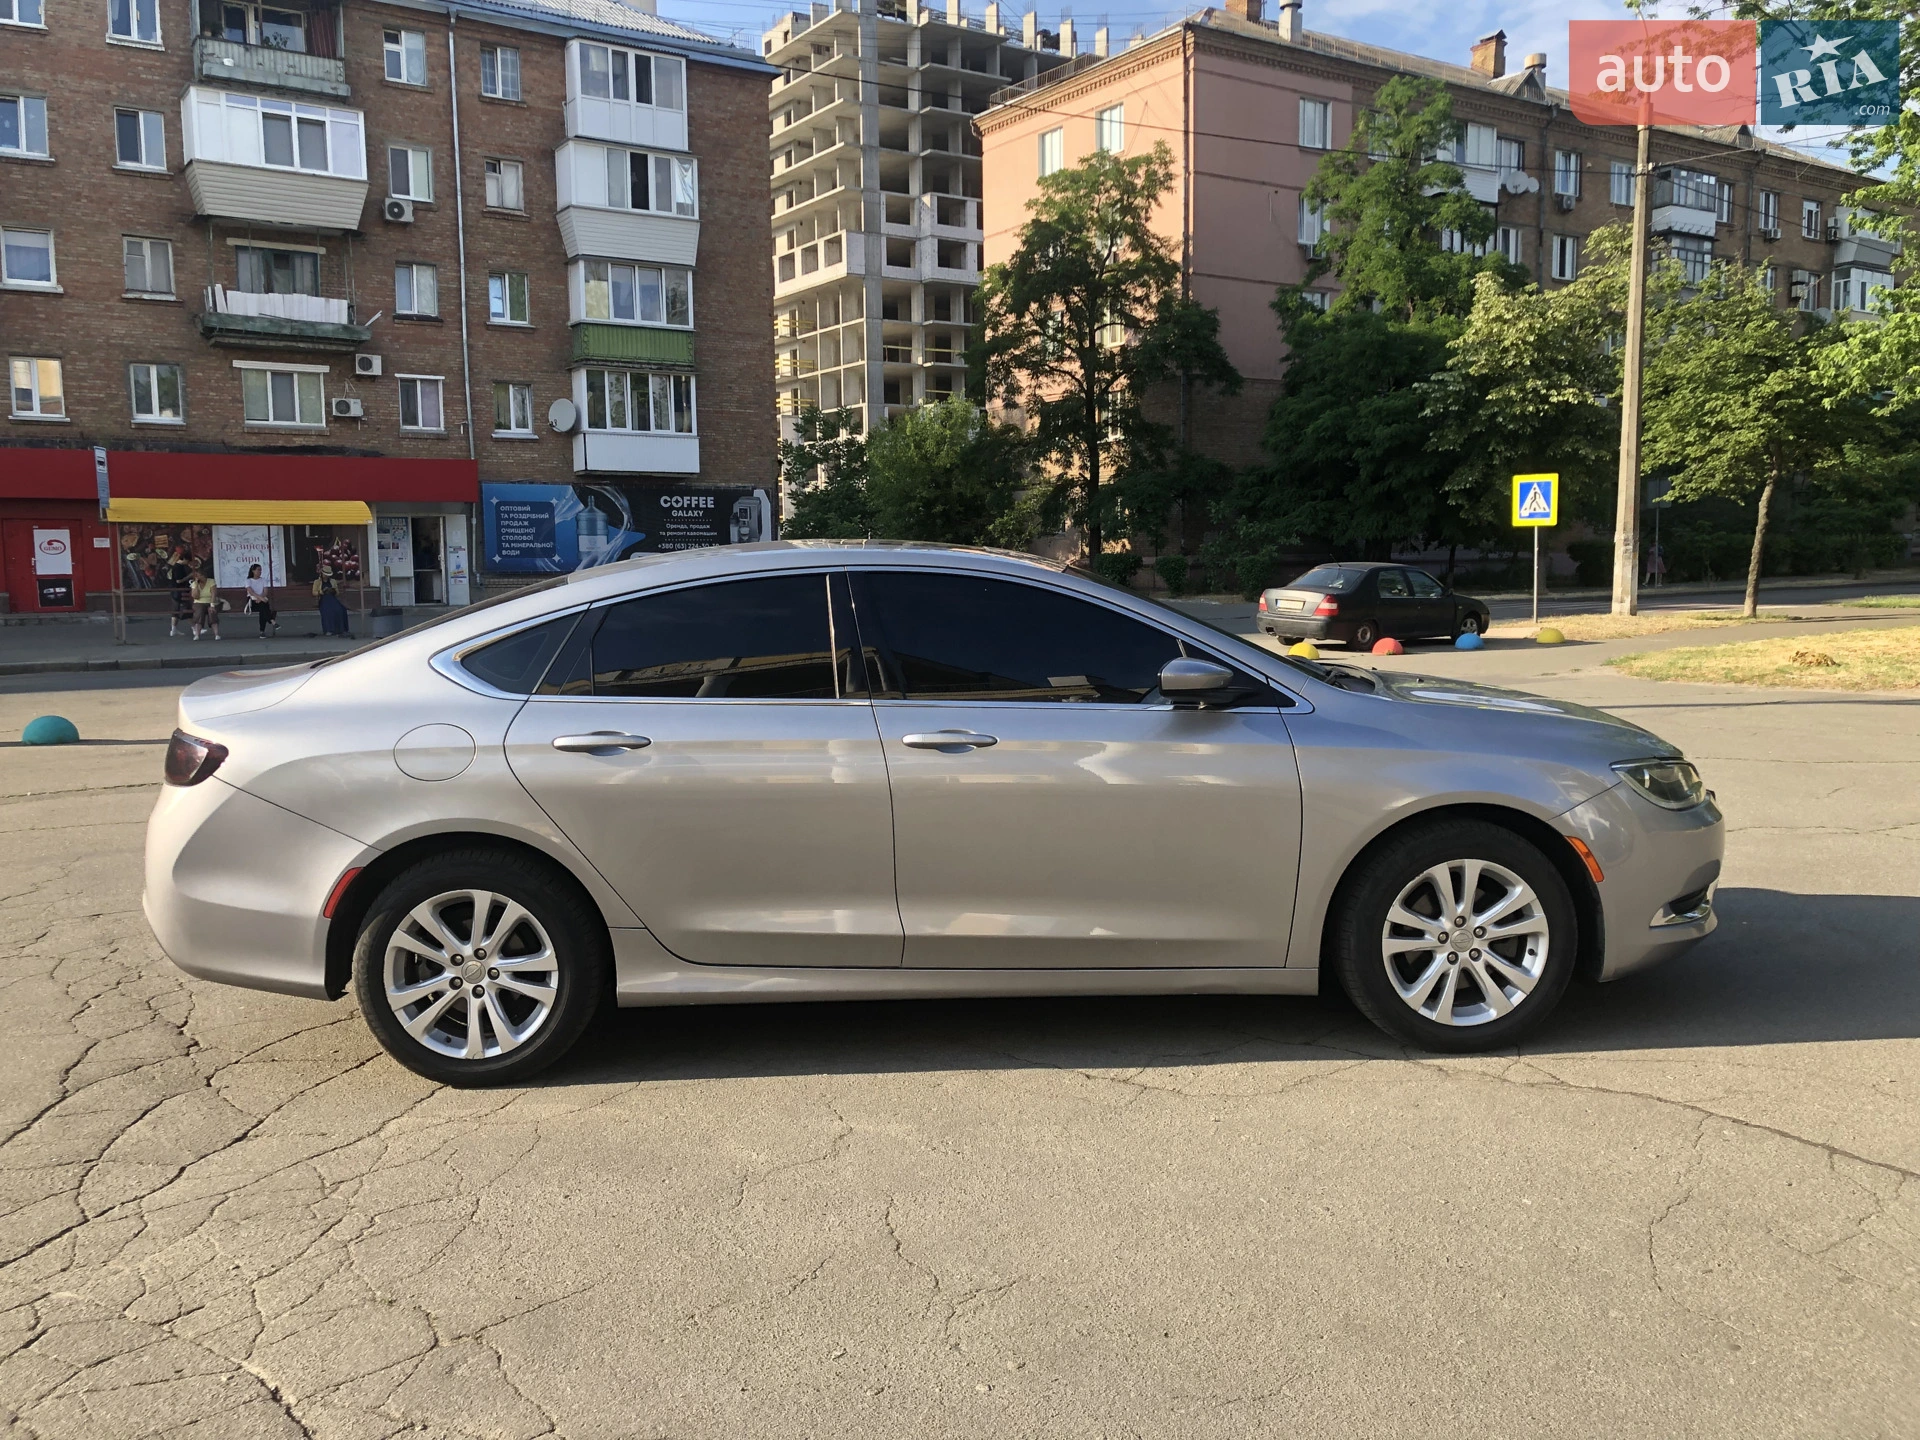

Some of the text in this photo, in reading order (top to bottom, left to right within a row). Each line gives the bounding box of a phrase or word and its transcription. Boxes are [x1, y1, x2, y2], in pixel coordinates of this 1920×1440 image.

[660, 495, 715, 508] COFFEE
[501, 526, 536, 534] ОЧИЩЕНОЇ
[235, 556, 260, 565] сири
